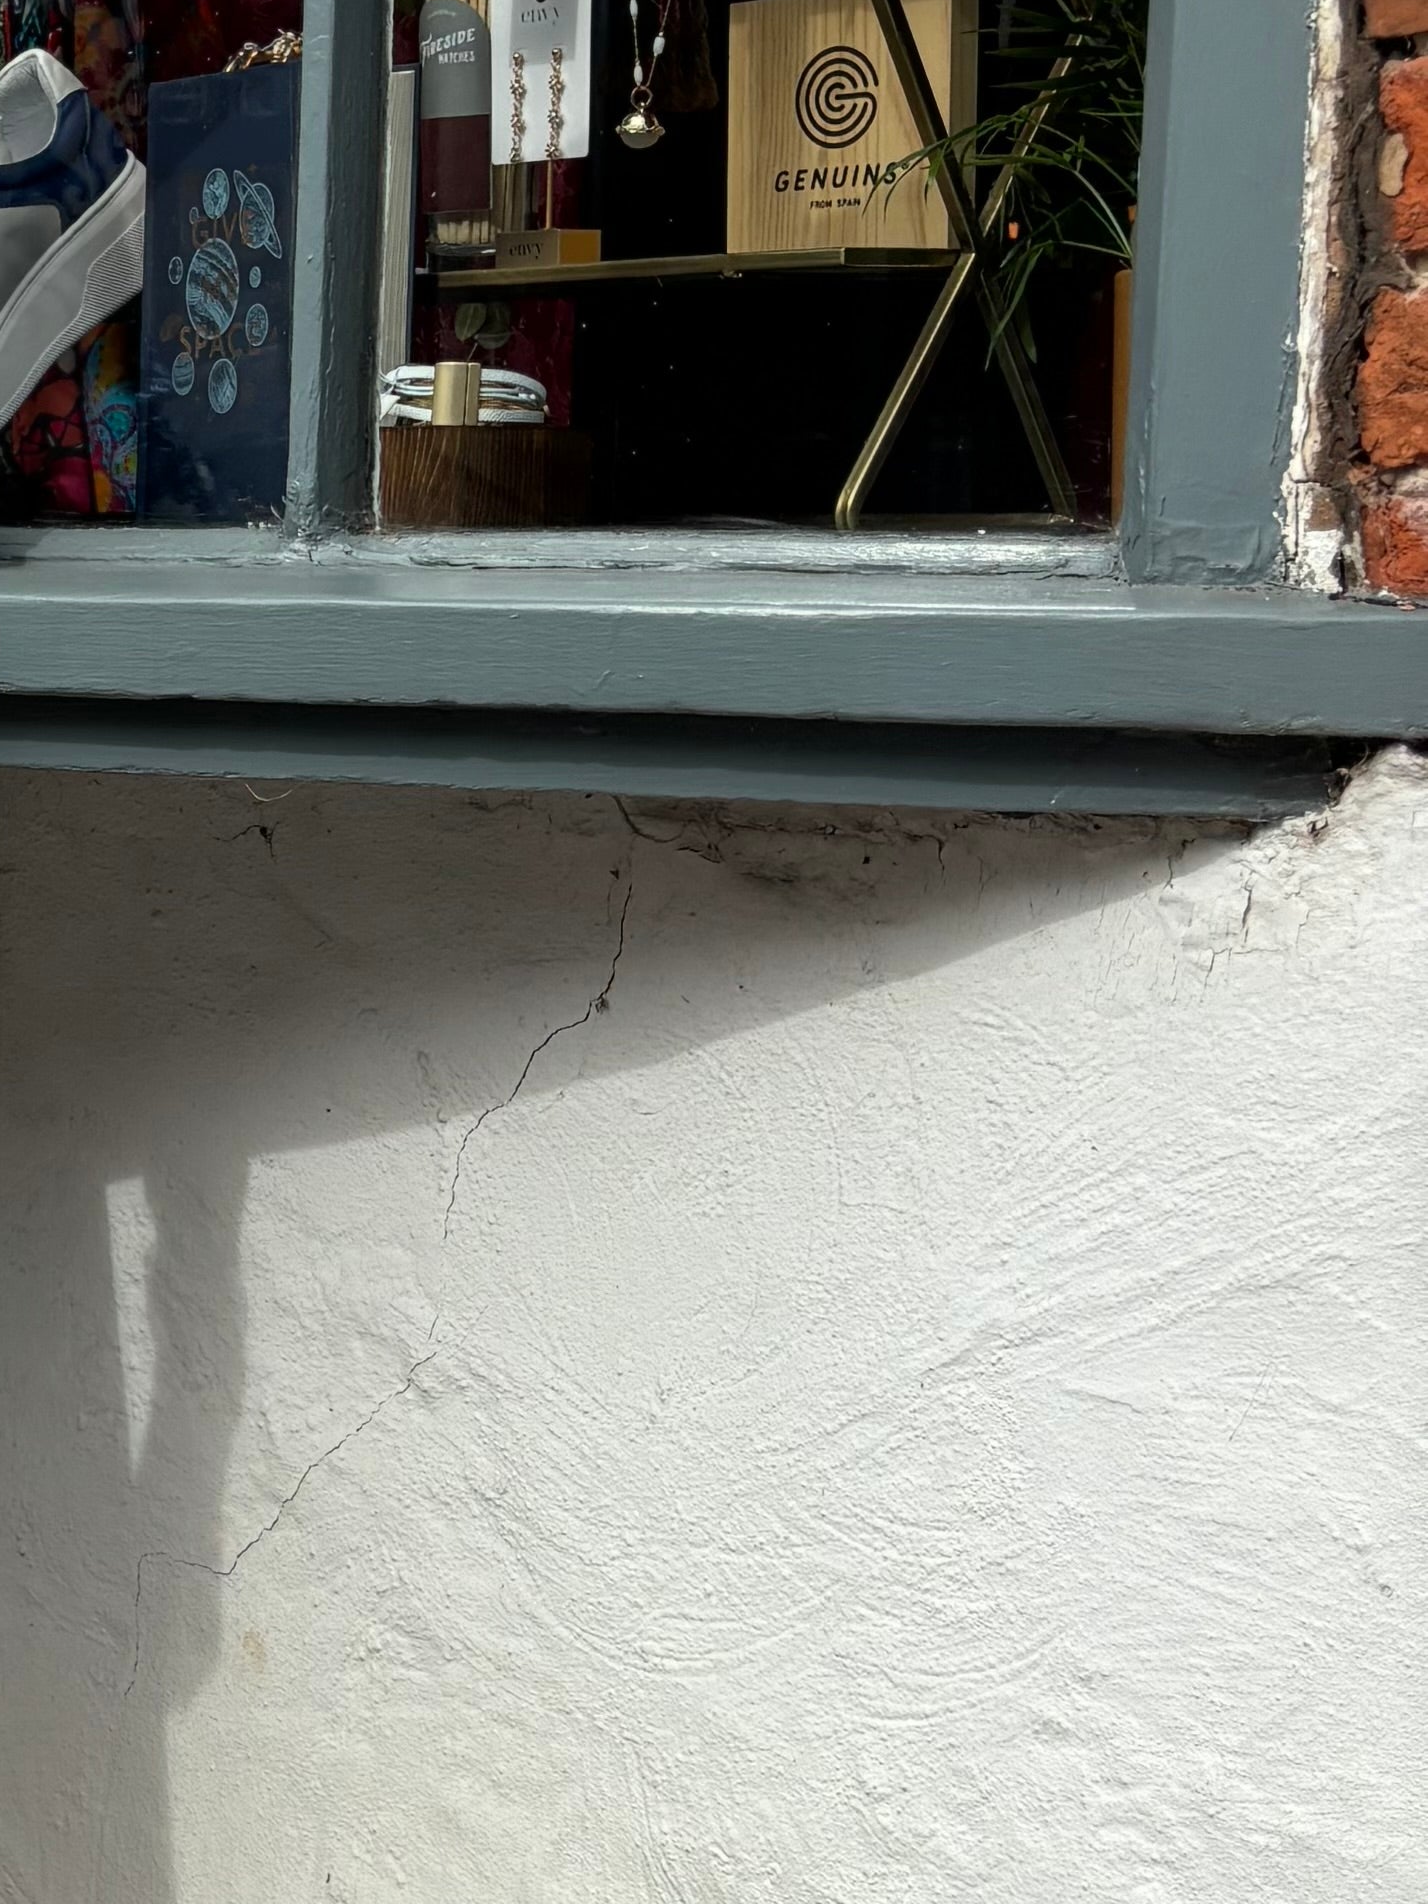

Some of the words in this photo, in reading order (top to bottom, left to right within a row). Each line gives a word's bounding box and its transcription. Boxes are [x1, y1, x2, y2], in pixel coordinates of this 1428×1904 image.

[774, 161, 896, 193] GENUINS
[810, 199, 833, 210] FROM
[837, 197, 861, 209] SPAIN
